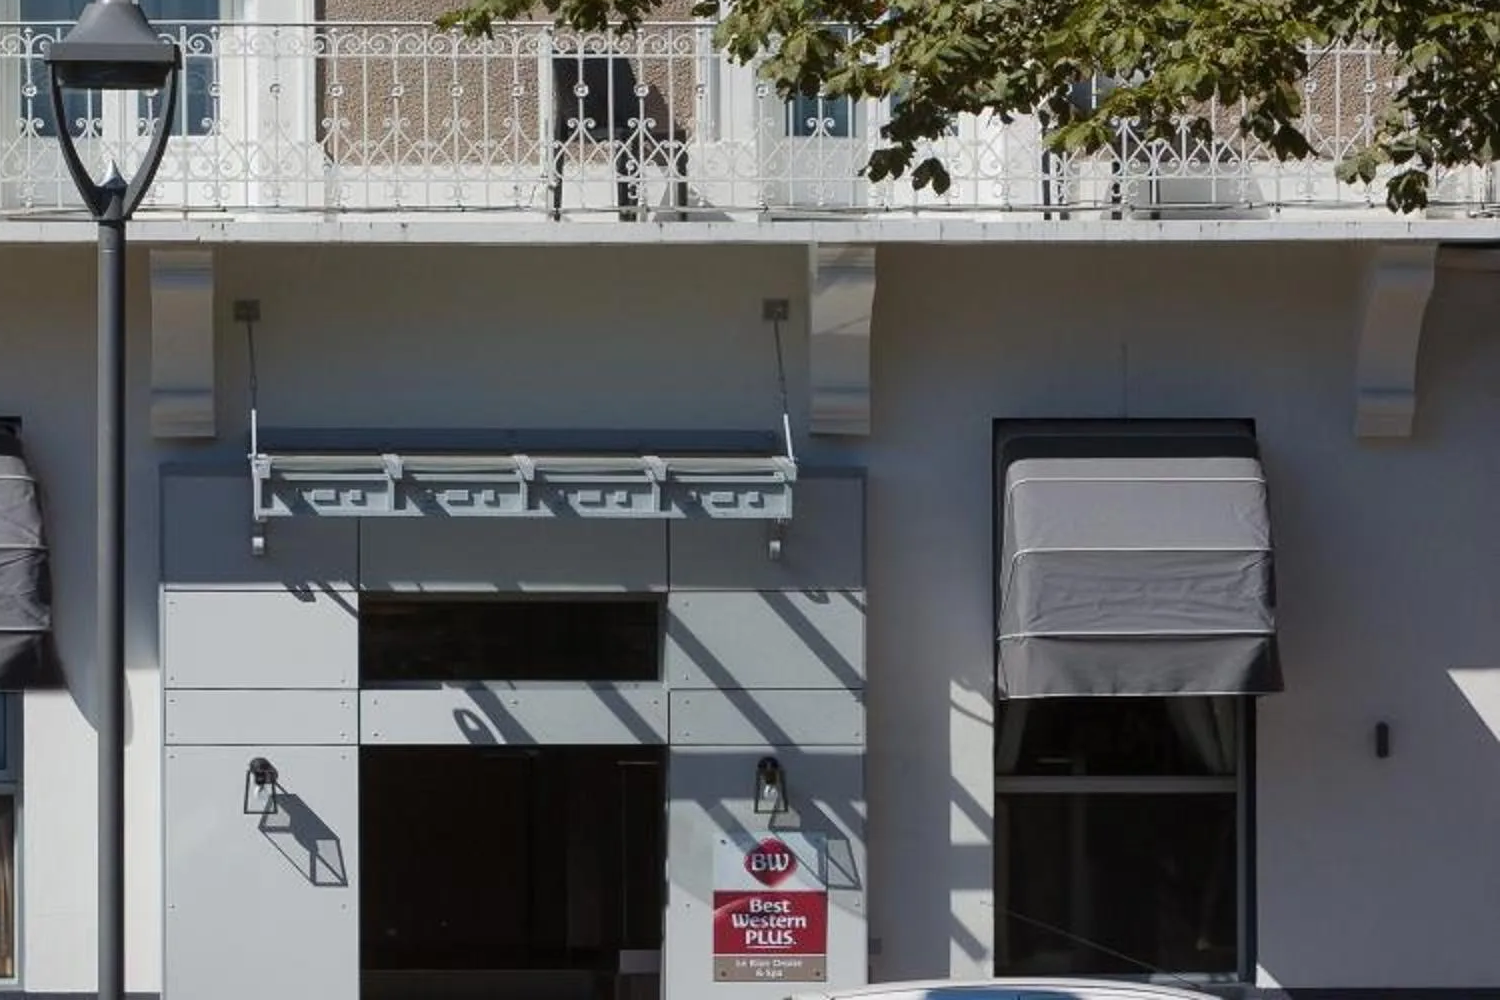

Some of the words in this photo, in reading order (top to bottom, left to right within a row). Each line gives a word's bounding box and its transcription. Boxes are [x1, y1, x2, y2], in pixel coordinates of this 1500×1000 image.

[751, 853, 789, 871] BW
[750, 899, 791, 912] Best
[732, 913, 807, 928] Western
